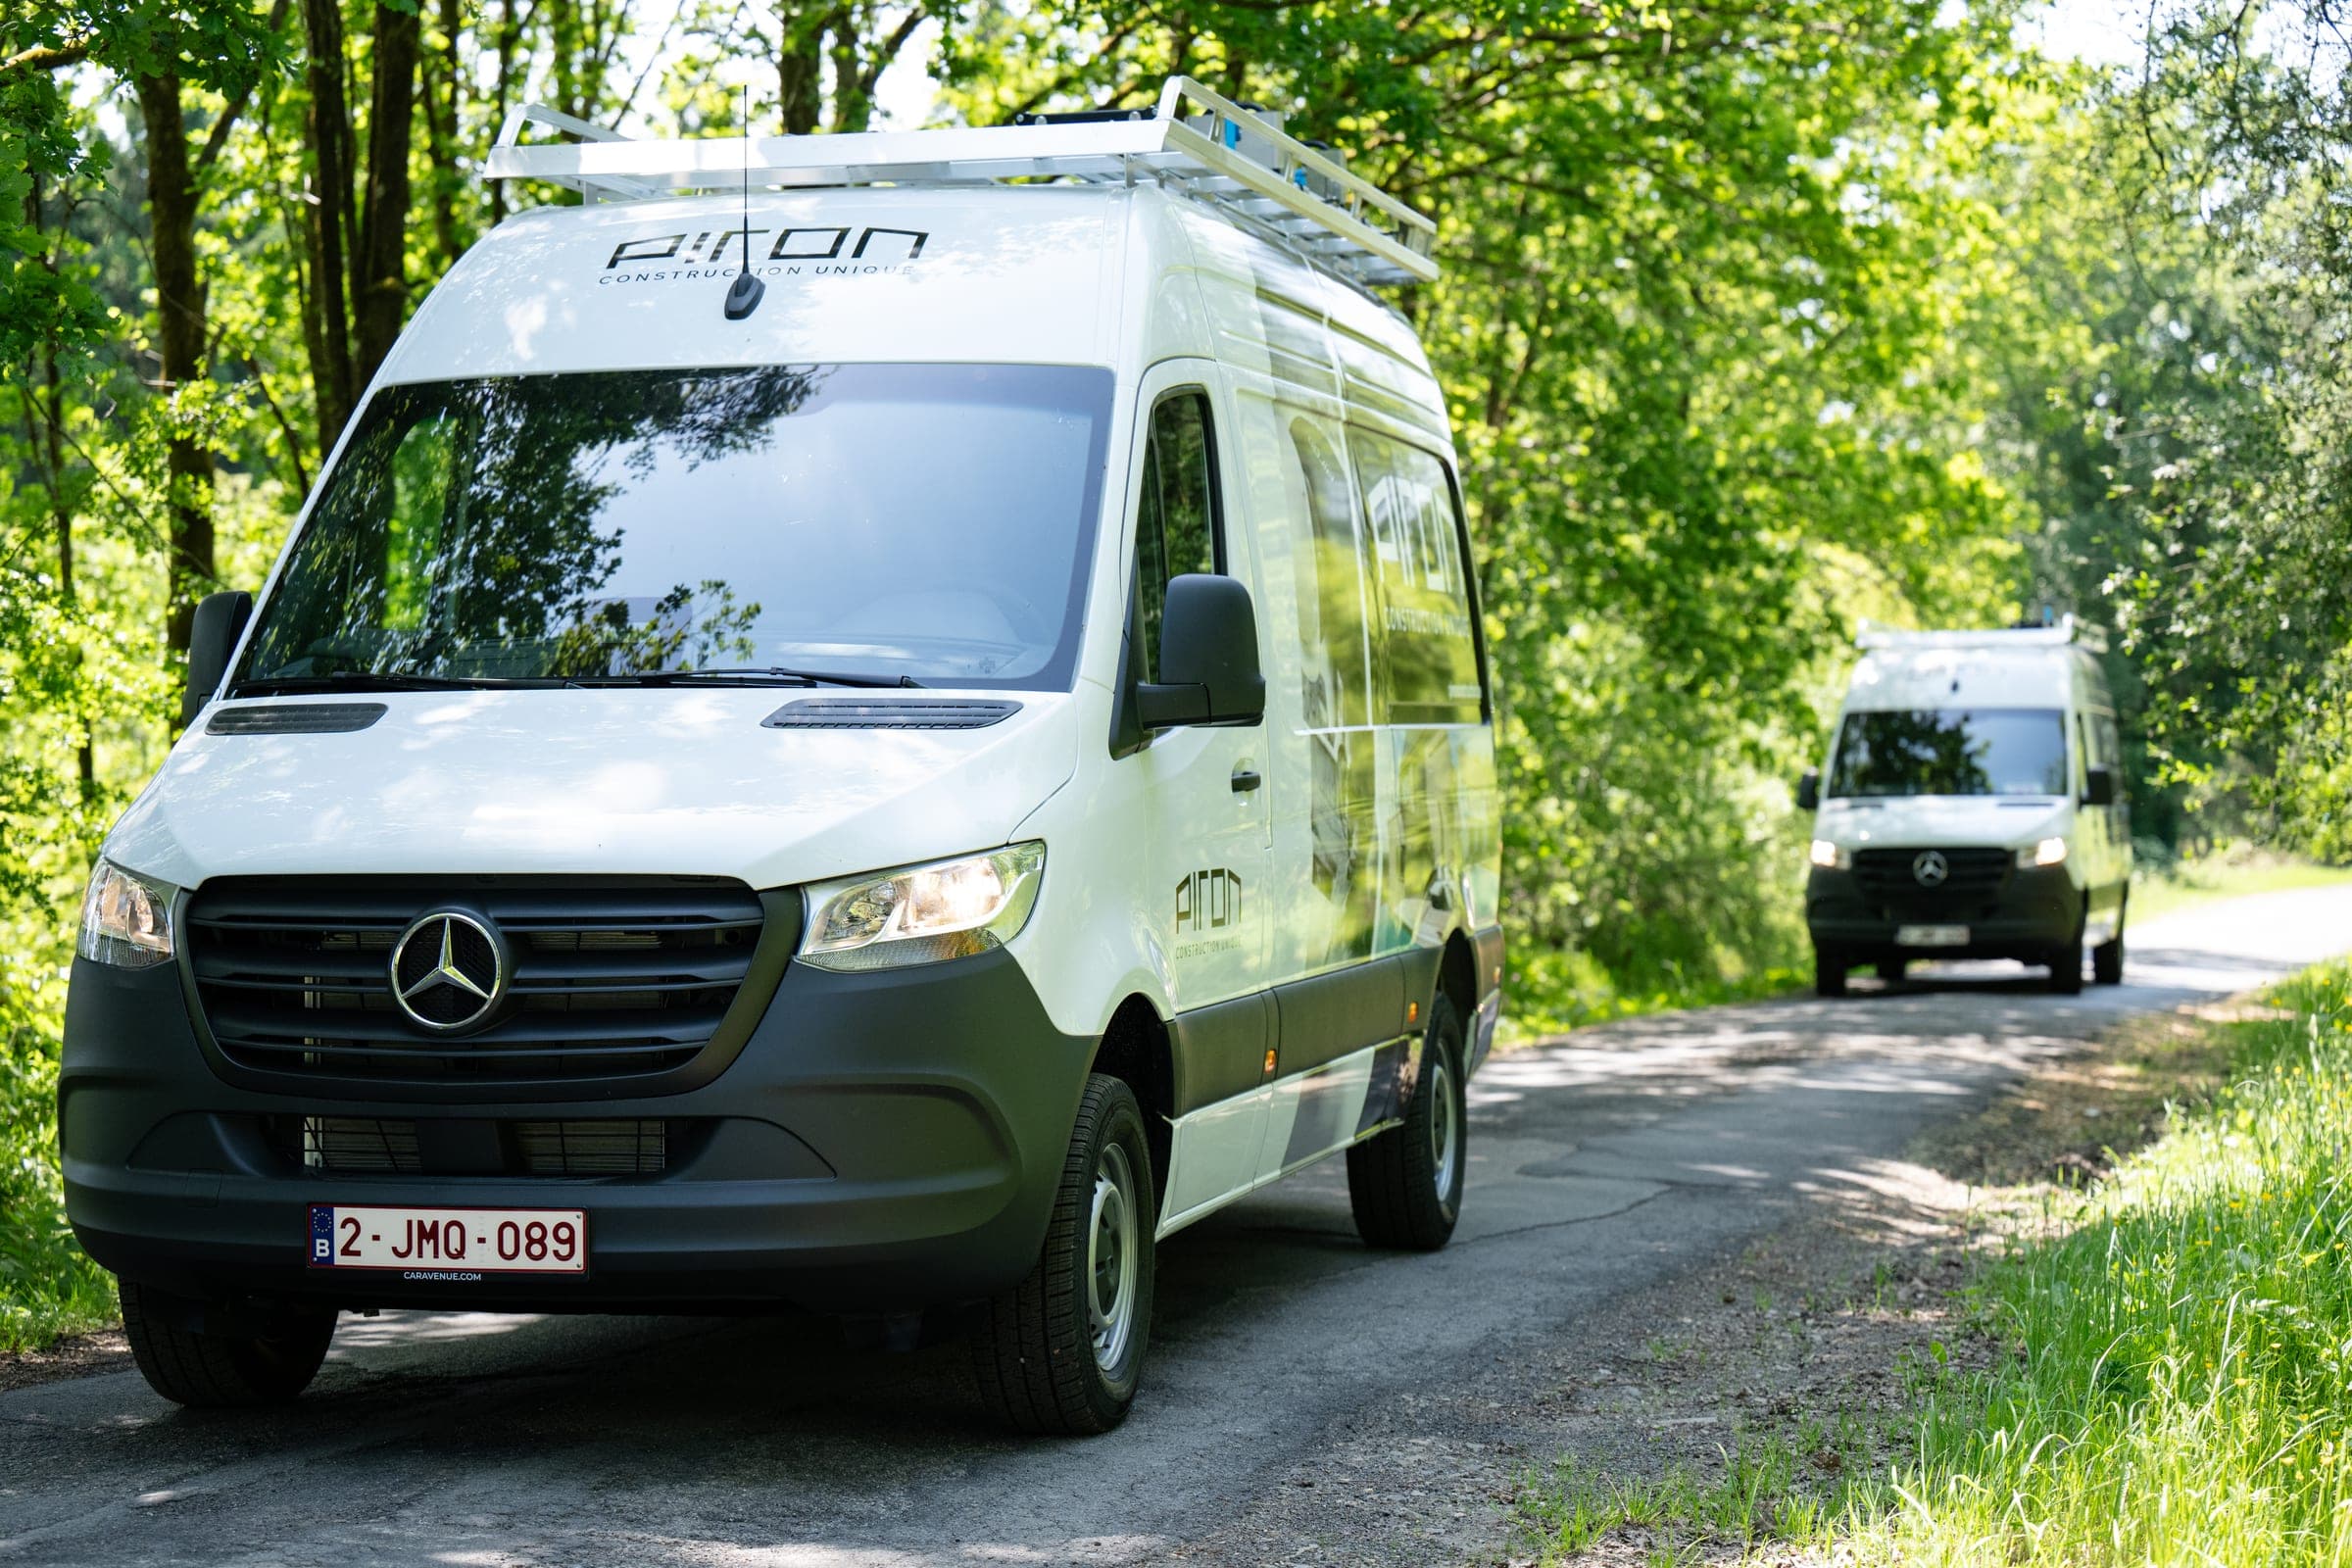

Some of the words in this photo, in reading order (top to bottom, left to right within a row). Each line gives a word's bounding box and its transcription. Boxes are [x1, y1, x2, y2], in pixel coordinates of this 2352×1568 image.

[598, 266, 802, 285] CONSTRUCION
[814, 265, 915, 275] UNIQUE
[316, 1239, 329, 1257] B
[339, 1216, 576, 1262] 2-JMQ-089
[403, 1271, 482, 1282] CARAVENUE.COM
